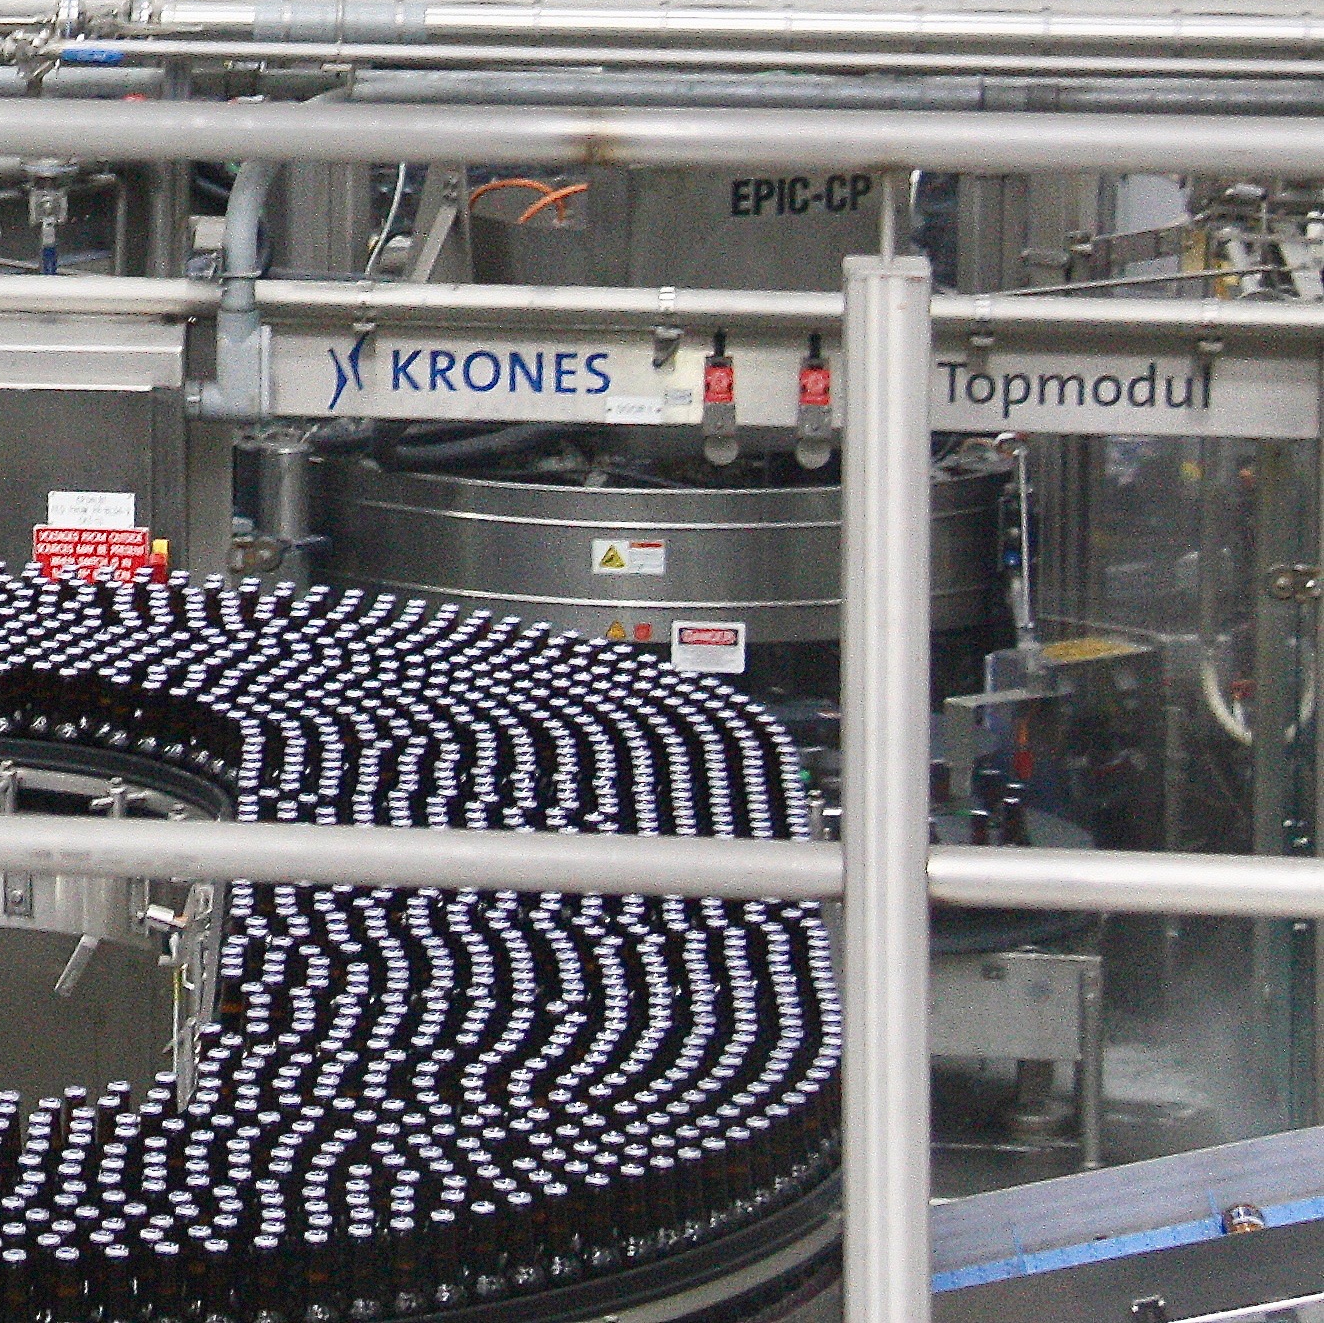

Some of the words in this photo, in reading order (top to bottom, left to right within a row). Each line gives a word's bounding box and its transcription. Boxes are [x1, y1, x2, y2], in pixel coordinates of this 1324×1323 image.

[730, 173, 873, 217] EPIC-CP
[390, 348, 612, 395] KRONES
[937, 356, 1213, 418] Topmodul
